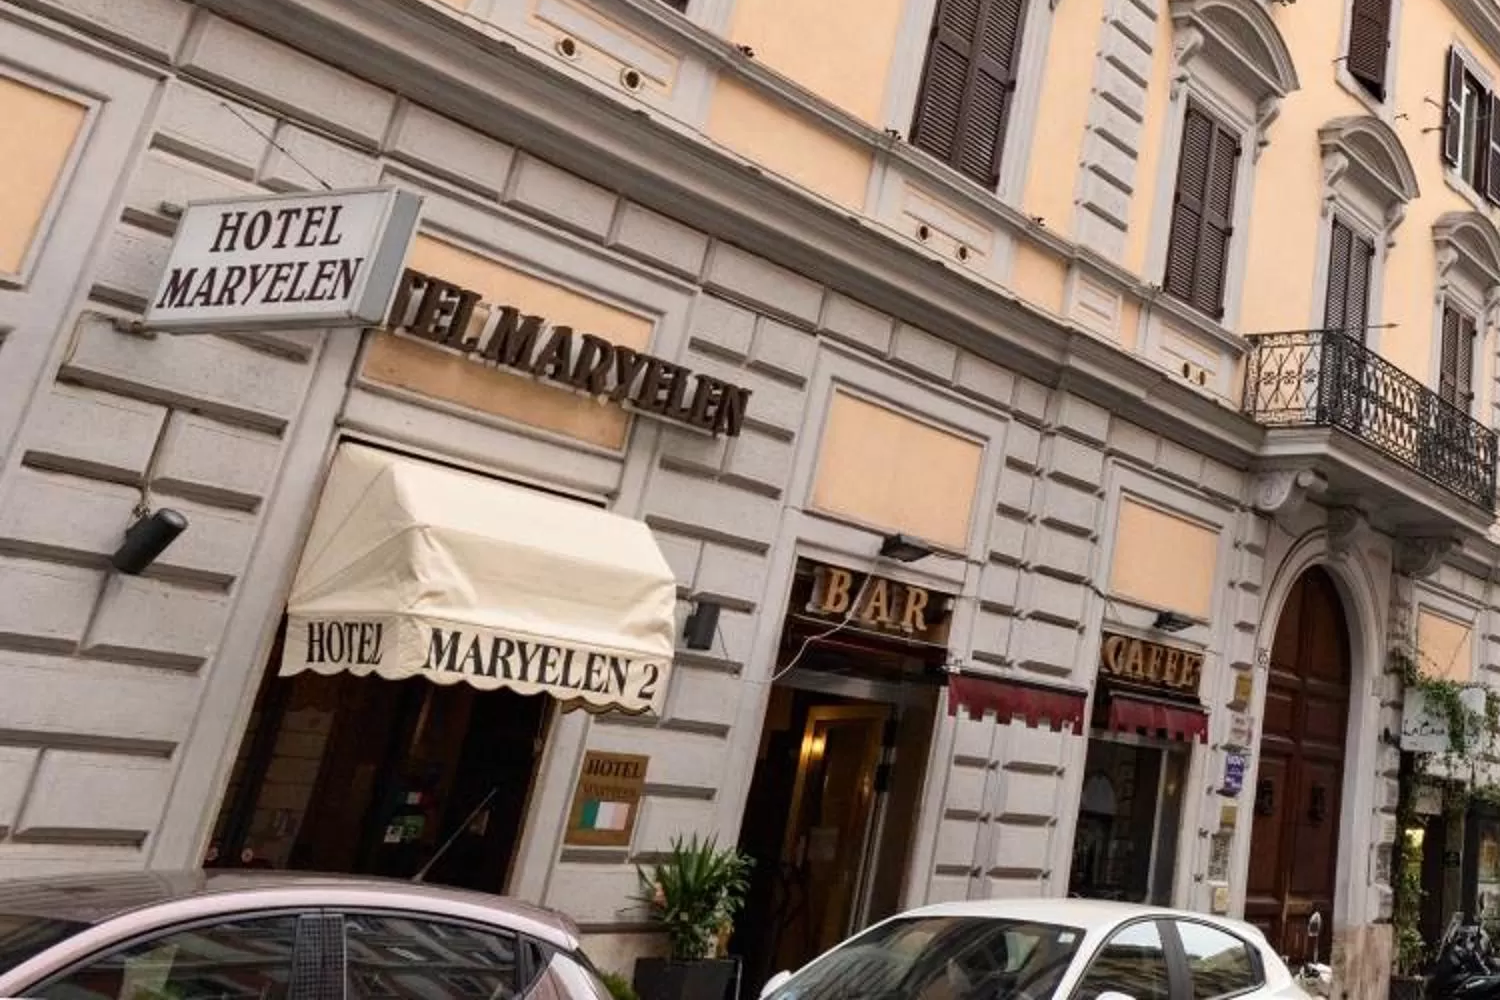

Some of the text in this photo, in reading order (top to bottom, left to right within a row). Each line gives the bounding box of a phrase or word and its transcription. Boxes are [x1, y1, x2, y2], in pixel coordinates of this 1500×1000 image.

[209, 205, 343, 252] HOTEL
[155, 257, 365, 309] MARYELEN
[386, 267, 753, 438] TEL MARYELEN
[812, 566, 929, 634] BAR
[306, 620, 661, 700] HOTEL MARYELEN 2
[583, 760, 642, 777] HOTEL
